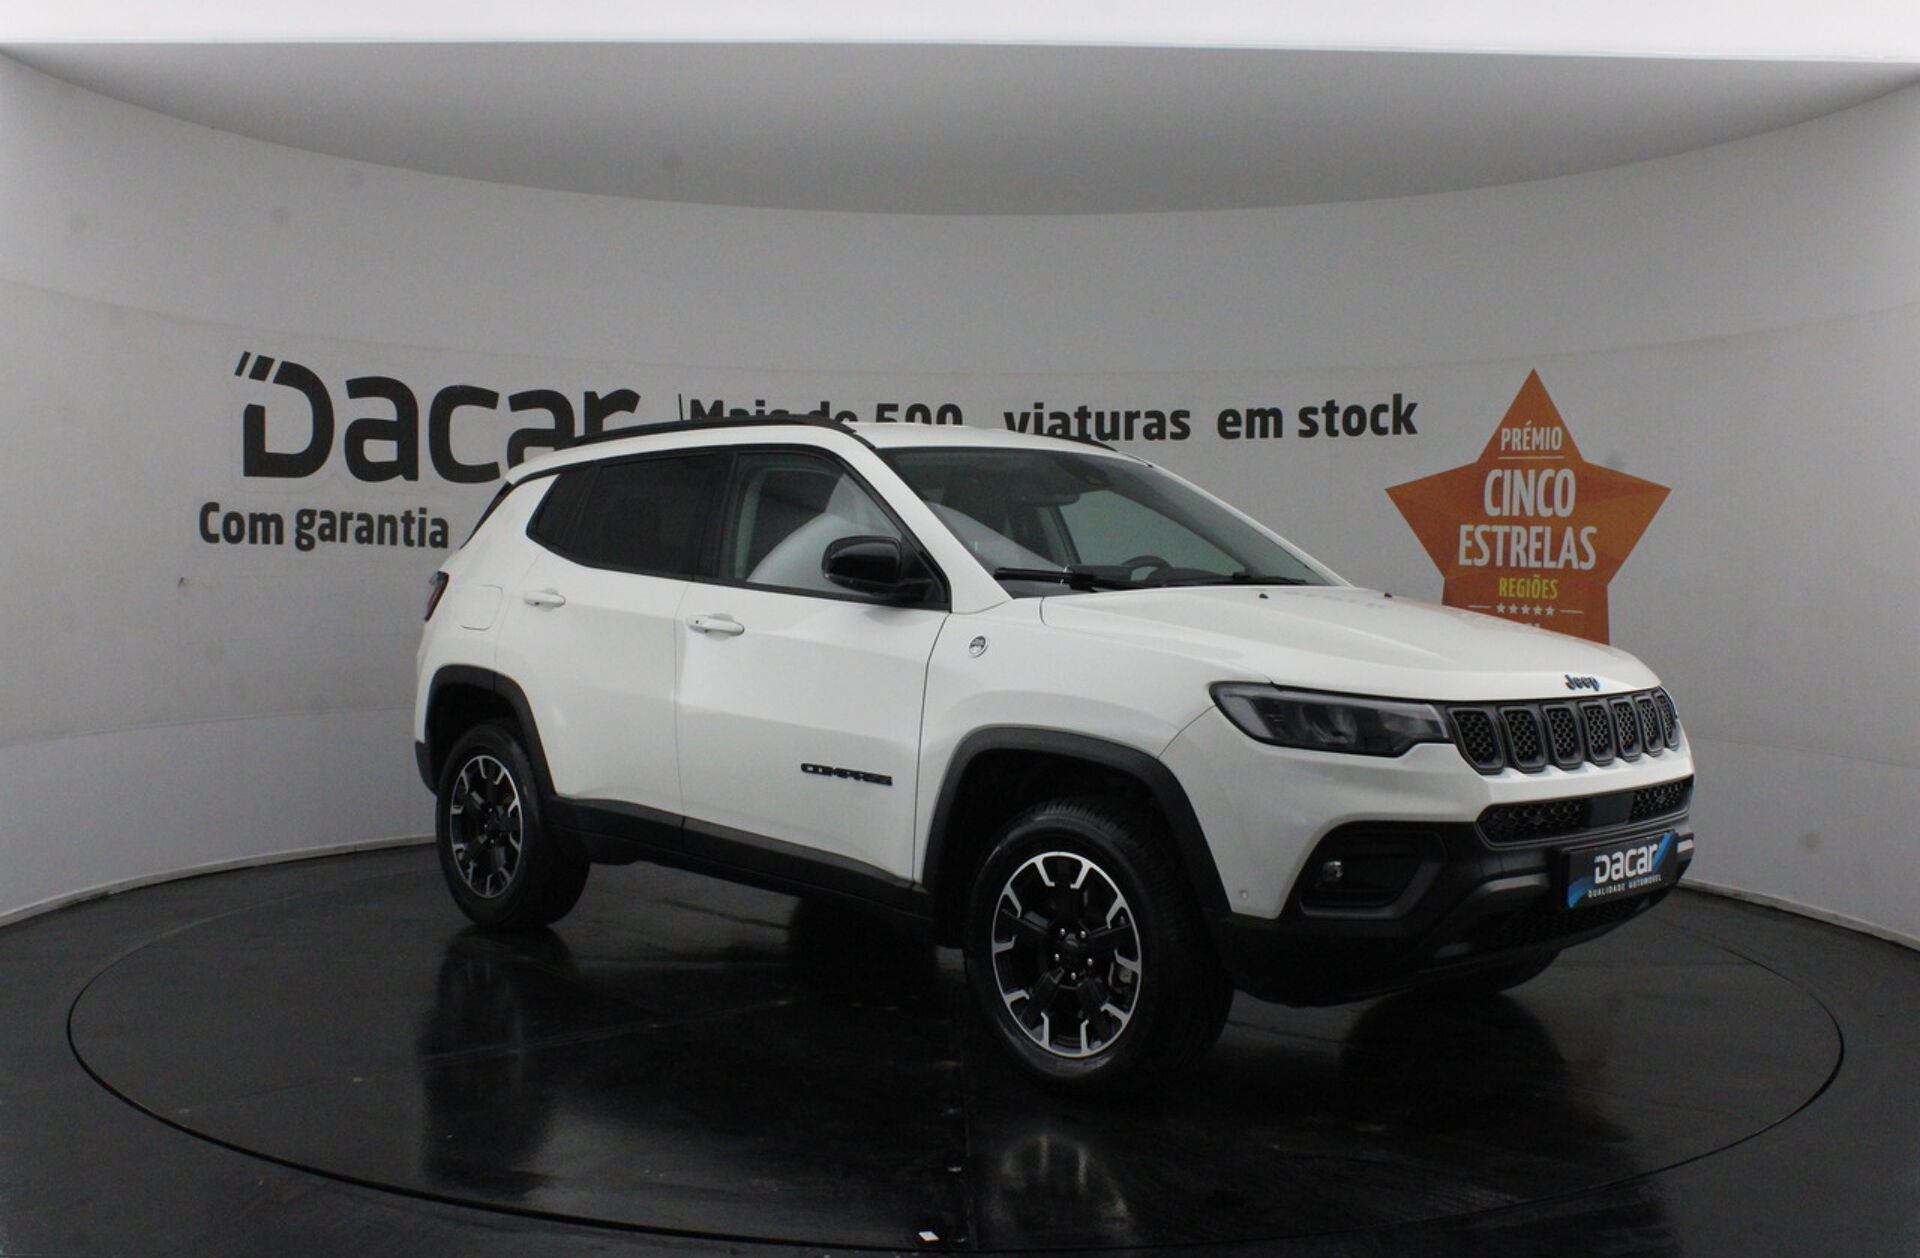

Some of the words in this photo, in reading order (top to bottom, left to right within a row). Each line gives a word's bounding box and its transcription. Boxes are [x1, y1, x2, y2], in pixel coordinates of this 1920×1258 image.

[1004, 402, 1191, 441] viaturas
[1217, 405, 1283, 439] em
[1298, 394, 1418, 437] stock
[1501, 420, 1562, 451] PRÉMIO
[1484, 468, 1576, 518] CINCO
[199, 501, 284, 545] Com
[295, 507, 449, 552] garantia
[1458, 525, 1597, 570] ESTRELAS
[1499, 574, 1558, 599] REGIÕES
[1564, 674, 1600, 692] Jeep
[1594, 843, 1658, 884] Dacar
